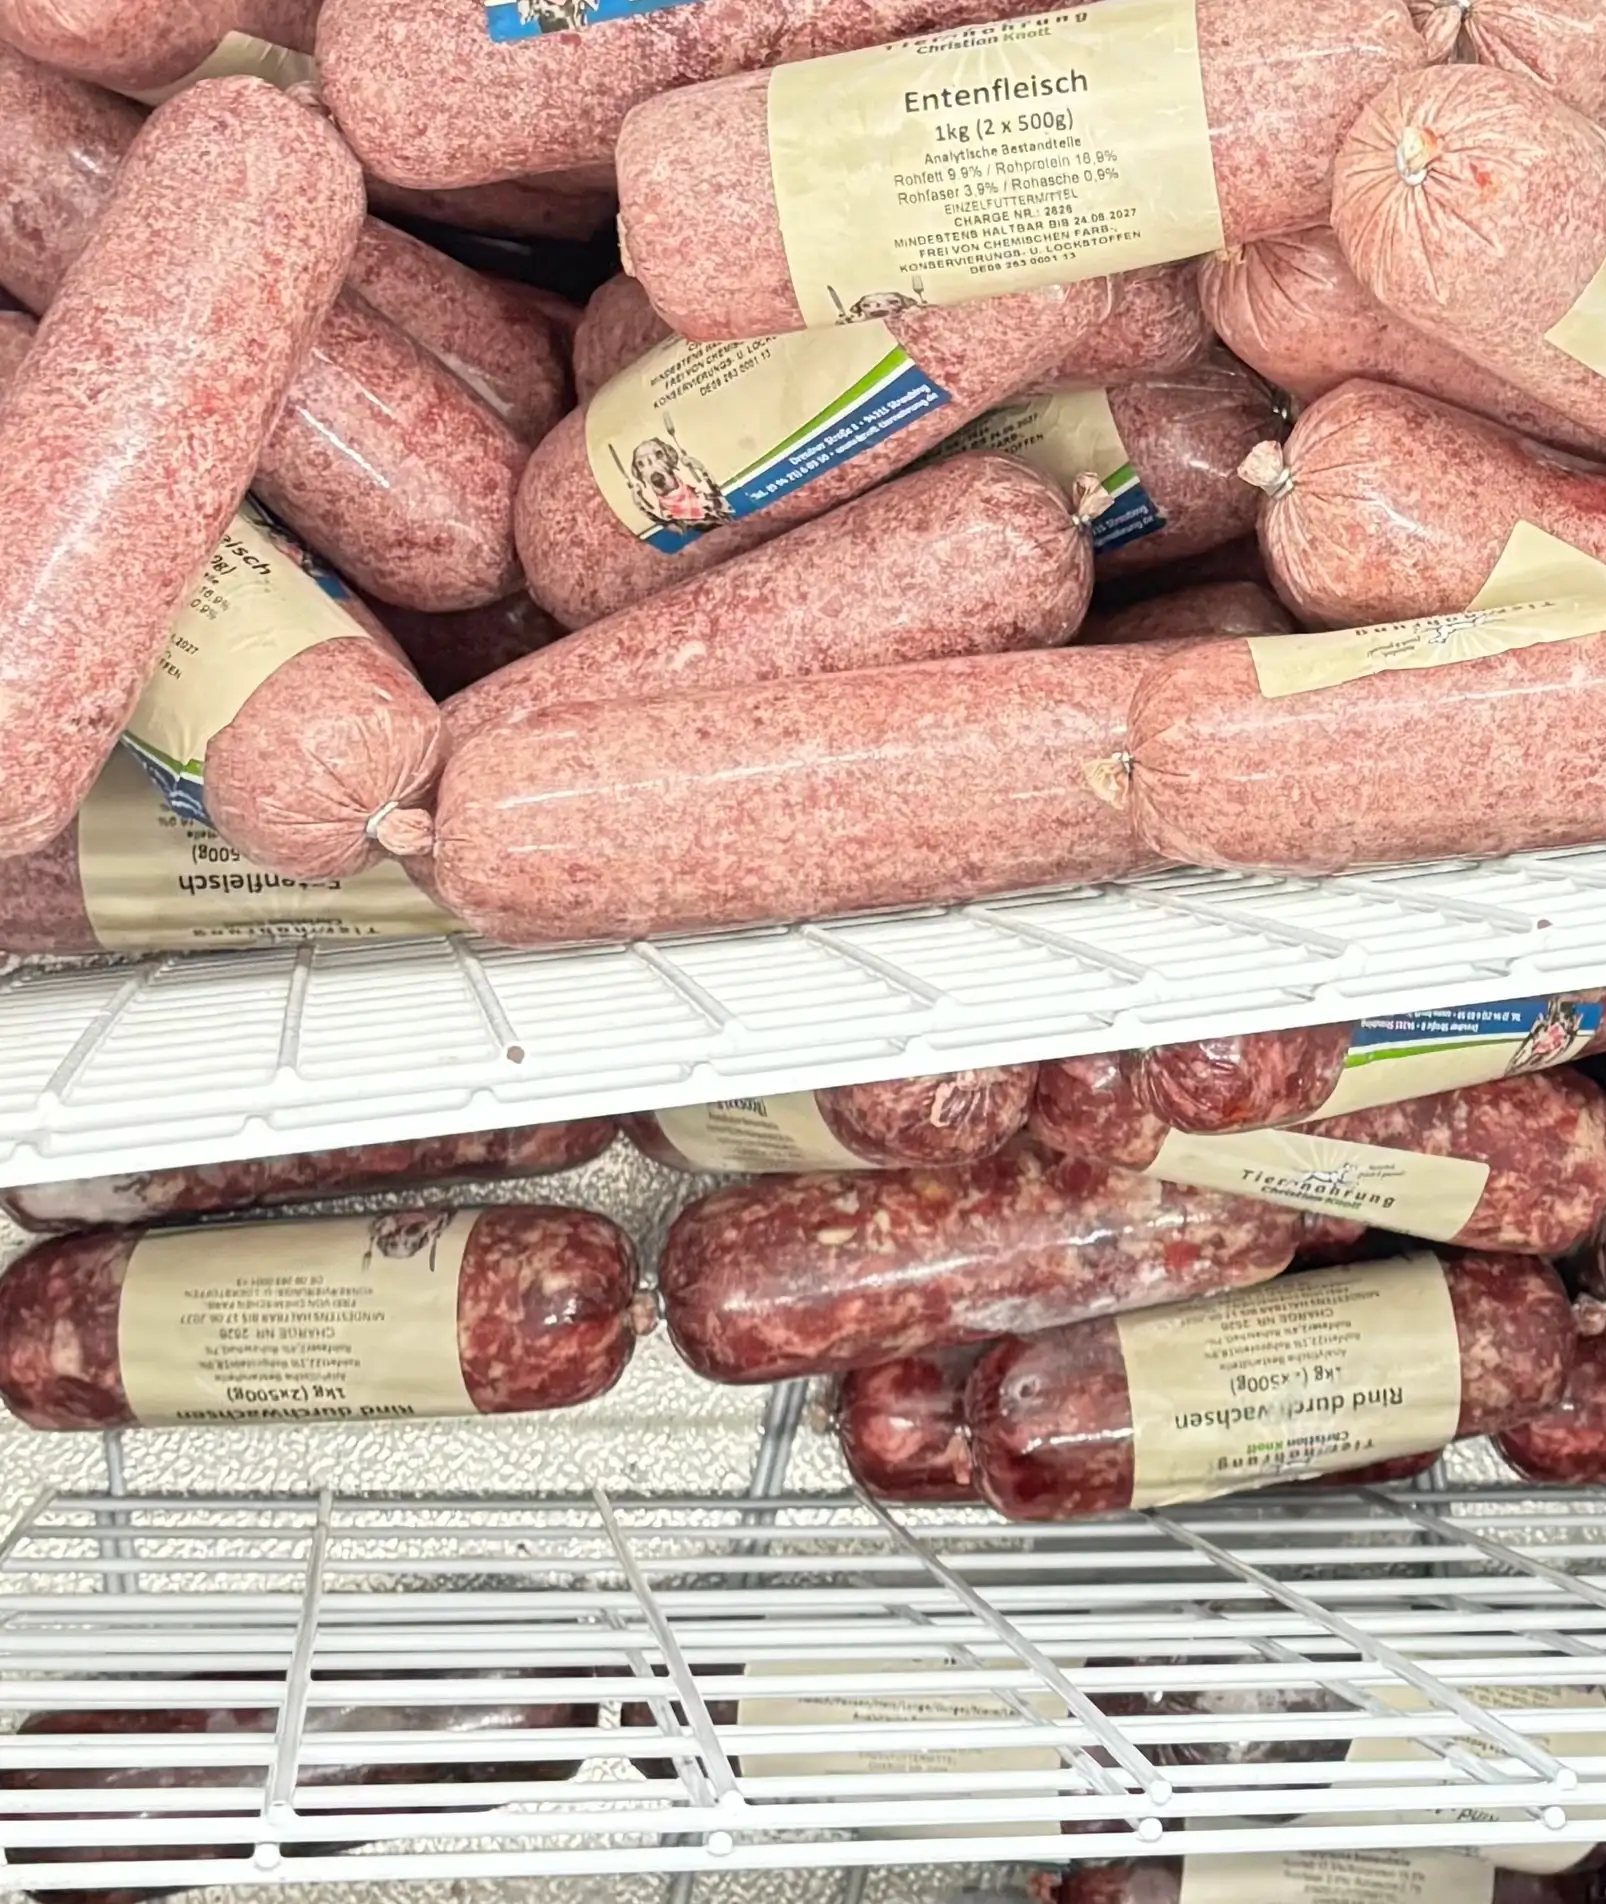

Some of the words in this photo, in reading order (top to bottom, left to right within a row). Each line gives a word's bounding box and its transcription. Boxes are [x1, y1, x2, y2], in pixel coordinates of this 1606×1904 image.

[917, 36, 998, 54] Christian
[905, 69, 1087, 113] Entenfleisch
[936, 124, 970, 143] 1kg
[977, 119, 995, 140] (2
[1002, 121, 1011, 133] x
[1018, 108, 1073, 131] 500g)
[925, 146, 997, 164] Analytische
[1001, 136, 1081, 155] Bestandteile
[894, 172, 943, 186] Rohfett
[996, 156, 1070, 175] Rohprotein
[898, 188, 959, 205] Rohfaser
[1012, 173, 1079, 190] Rohasche
[944, 189, 1078, 214] EINZELFUTTERMITTEL
[894, 230, 978, 248] MINDESTENS
[982, 221, 1044, 237] HALTBAR
[1049, 218, 1069, 229] BIS
[954, 212, 1009, 227] CHARGE
[900, 250, 1025, 272] KONSERVIERUNGS-
[1046, 232, 1141, 252] LOCKSTOFFEN
[920, 247, 948, 258] FREI
[952, 244, 980, 254] VON
[984, 232, 1070, 249] CHEMISCHEN
[1353, 1388, 1403, 1411] Rind
[1287, 1431, 1349, 1447] Christian
